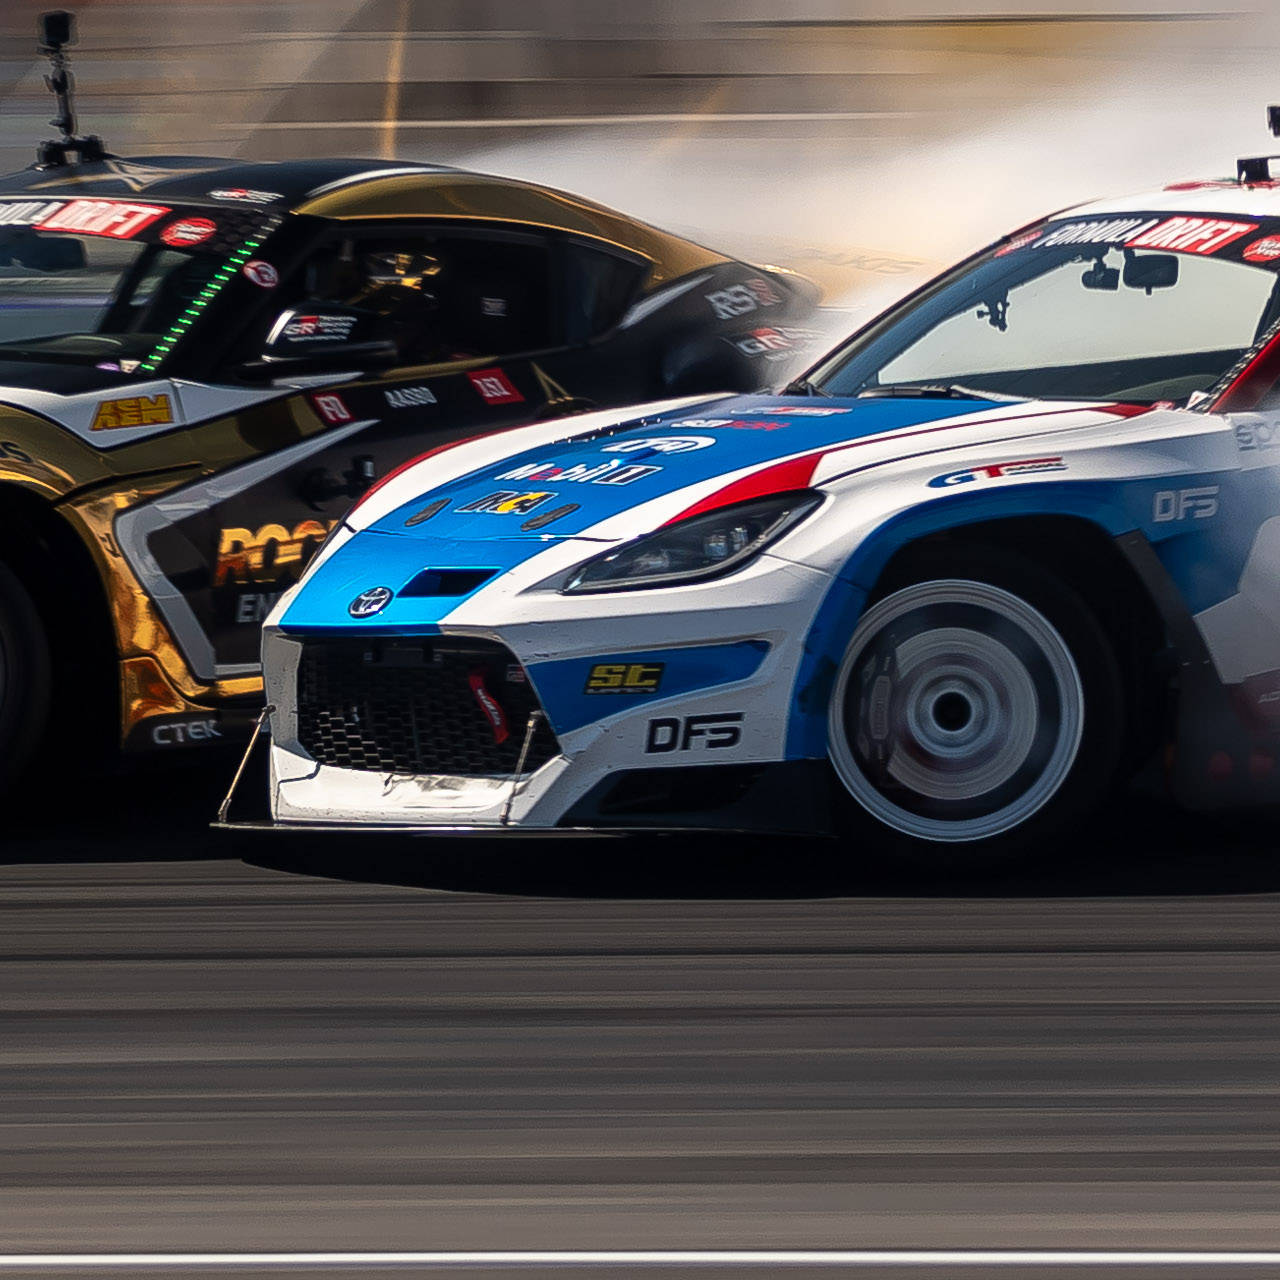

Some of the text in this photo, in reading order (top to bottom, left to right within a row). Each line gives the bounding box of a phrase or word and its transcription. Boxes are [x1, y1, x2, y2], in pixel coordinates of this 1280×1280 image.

[1032, 219, 1160, 249] FORMULA
[1132, 217, 1246, 252] DRIFT
[494, 463, 620, 483] Mobil
[215, 520, 337, 587] ROC
[153, 720, 222, 745] CTEK
